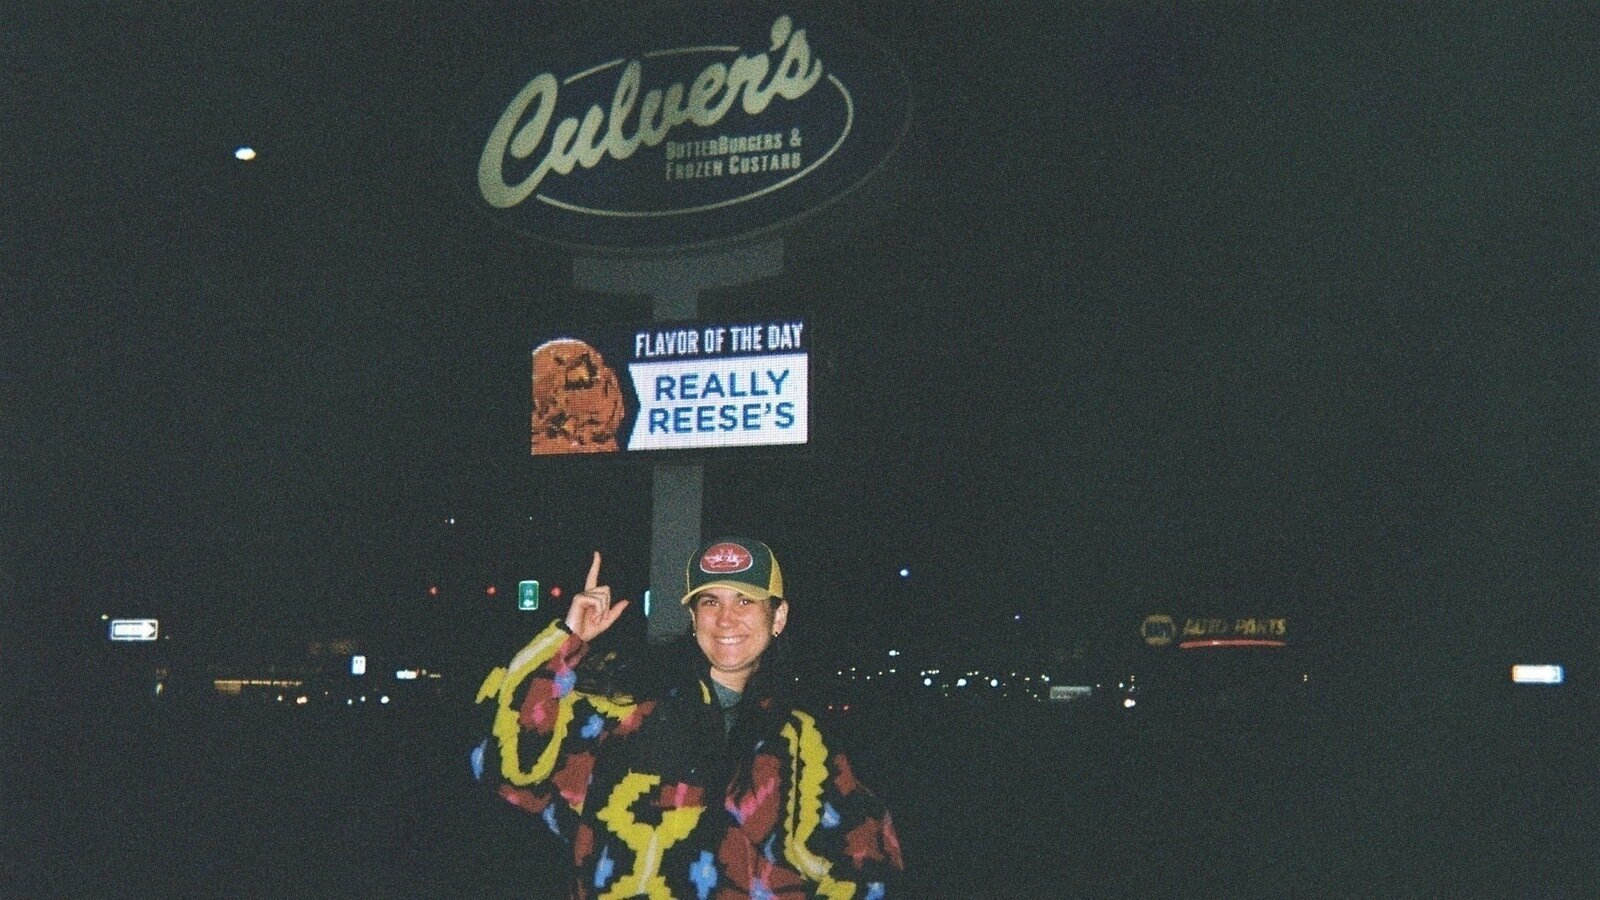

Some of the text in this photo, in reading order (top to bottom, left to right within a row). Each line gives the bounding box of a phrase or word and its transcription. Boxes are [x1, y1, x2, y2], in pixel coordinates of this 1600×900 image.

[478, 15, 823, 208] Culver's
[789, 128, 802, 148] &
[665, 152, 801, 180] FROZEN CUSTARD
[635, 321, 804, 358] FLAVOR OF THE DAY
[655, 368, 790, 401] REALLY
[649, 401, 796, 435] REESE'S
